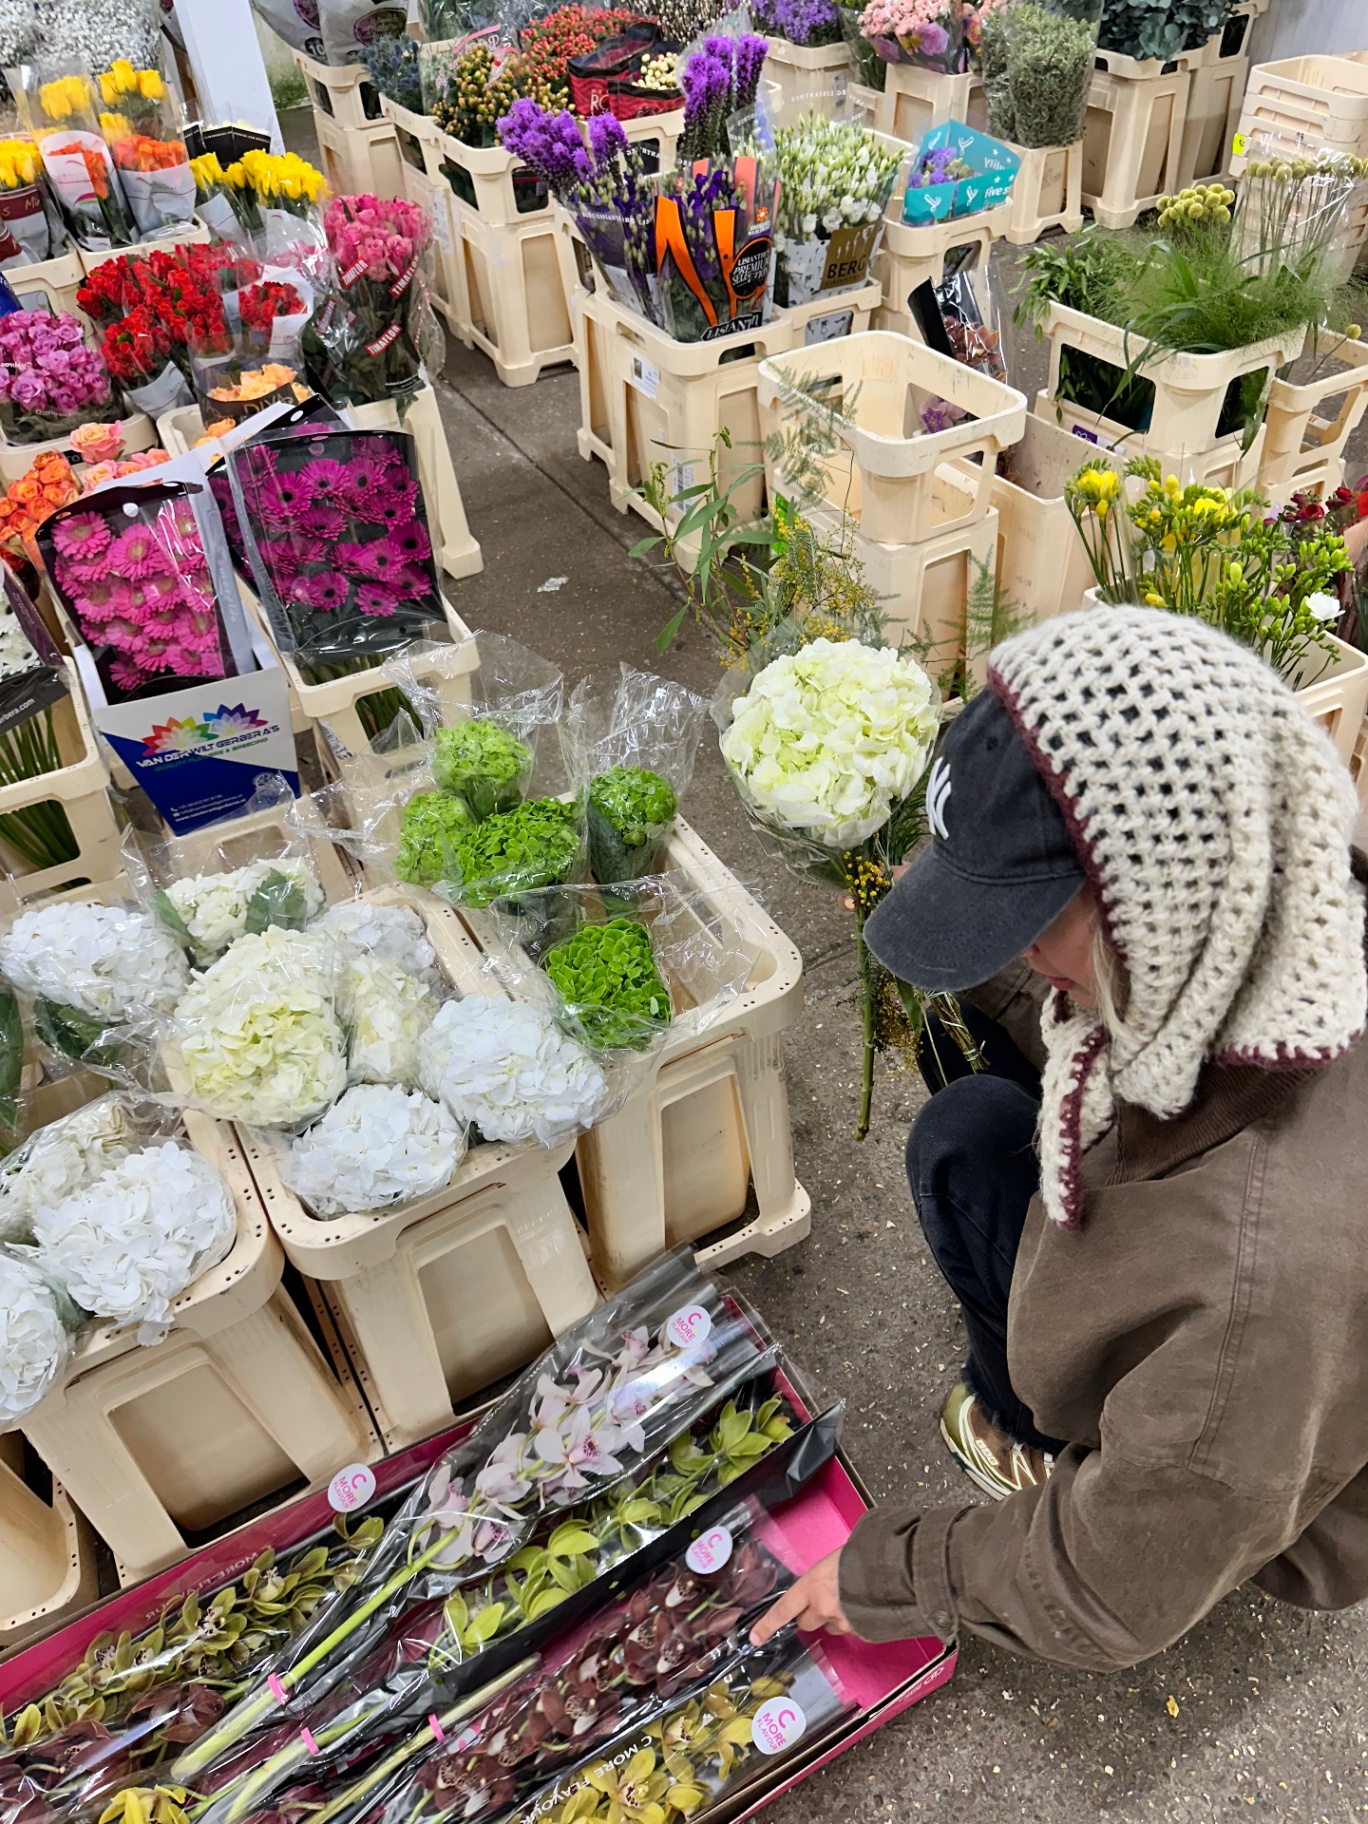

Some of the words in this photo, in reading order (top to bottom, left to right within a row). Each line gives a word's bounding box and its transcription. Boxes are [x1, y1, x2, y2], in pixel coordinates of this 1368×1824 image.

[391, 253, 420, 296] TIMAFLOR
[827, 254, 867, 279] BERG
[367, 324, 401, 355] TIMAFLOR
[136, 756, 163, 768] VAN
[164, 750, 190, 763] DER
[190, 743, 214, 756] WILT
[675, 1317, 696, 1341] MORE
[333, 1480, 350, 1509] FLAVOUR
[338, 1475, 358, 1505] MORE
[640, 1735, 653, 1747] C
[756, 1718, 778, 1752] FLAVOUR
[762, 1712, 787, 1747] MORE
[593, 1744, 639, 1778] MORE
